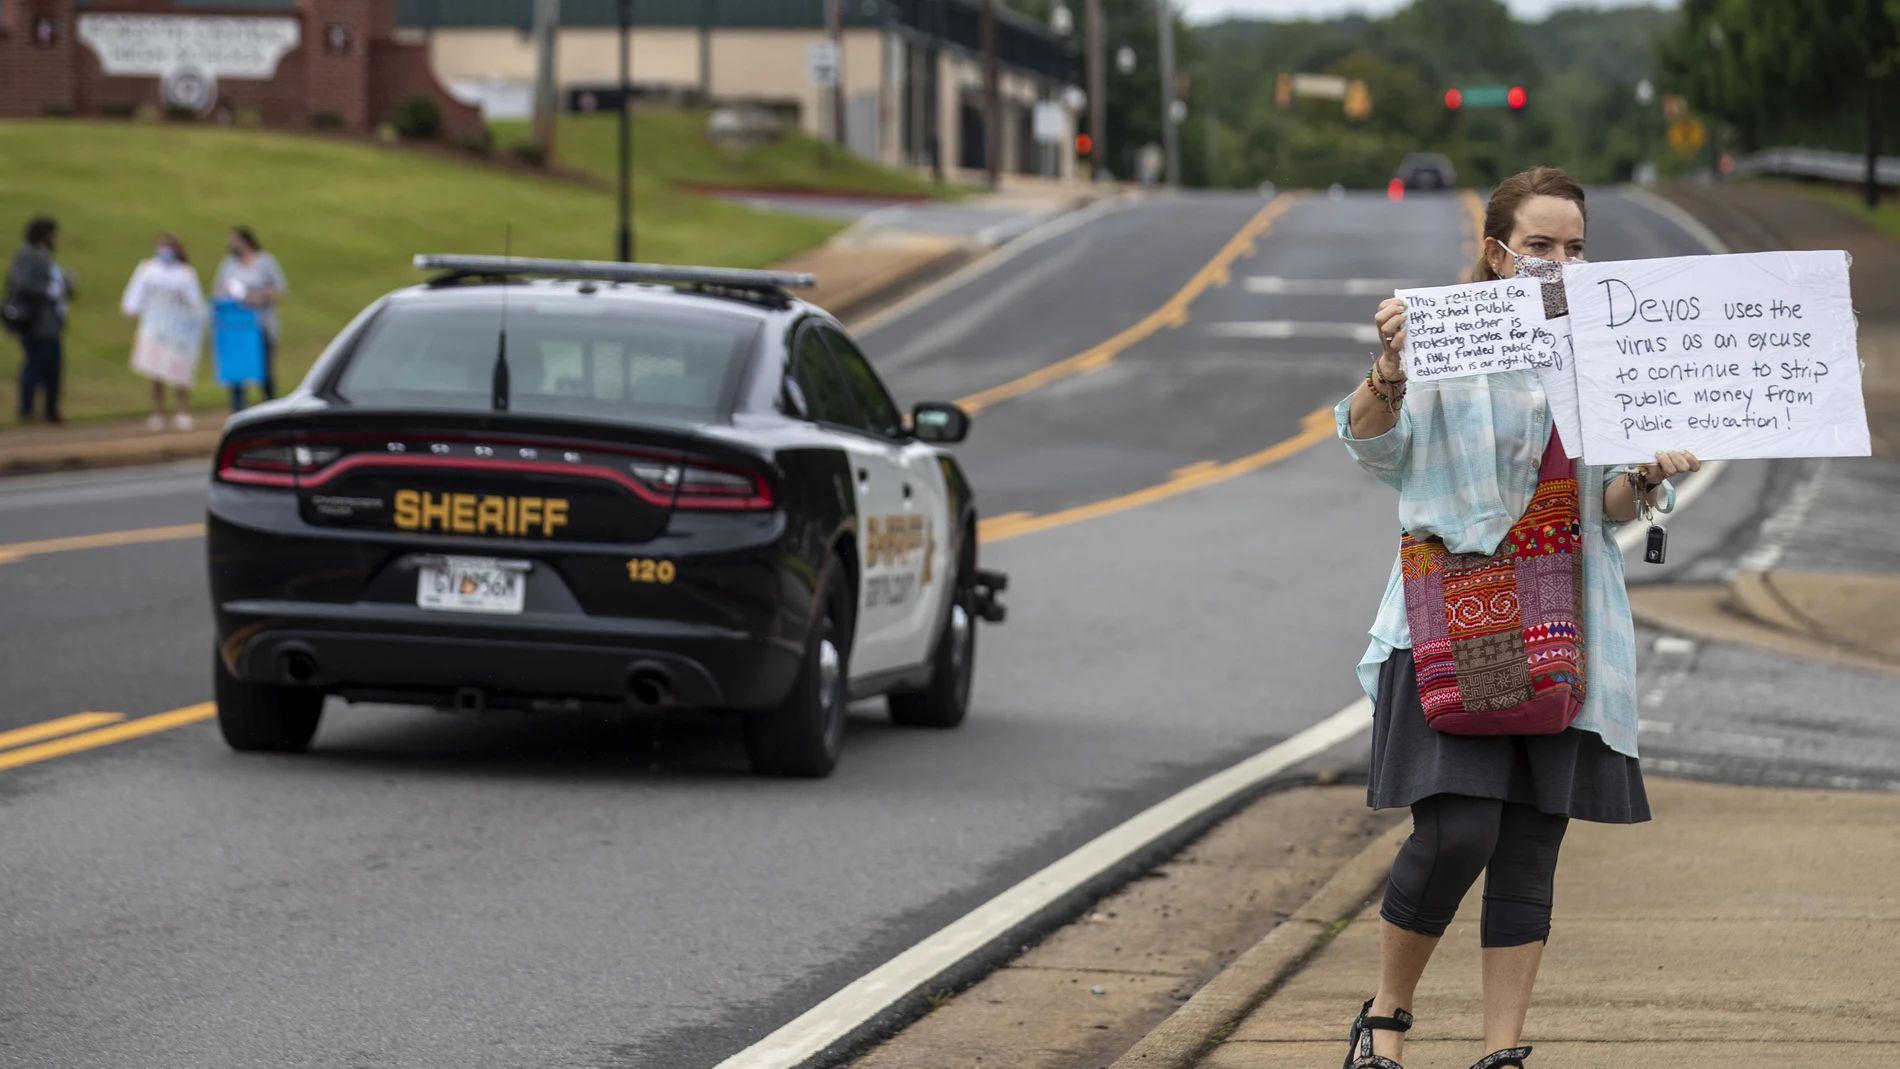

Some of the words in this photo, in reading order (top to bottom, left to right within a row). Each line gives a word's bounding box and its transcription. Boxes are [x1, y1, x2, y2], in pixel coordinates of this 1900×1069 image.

[1406, 295, 1436, 308] This
[1445, 287, 1498, 306] retired
[1724, 302, 1763, 320] uses
[1770, 298, 1803, 320] the
[1454, 319, 1504, 333] teacher
[1511, 317, 1522, 329] is
[1412, 335, 1465, 353] protesting
[1509, 328, 1528, 340] for
[1615, 334, 1668, 356] virus
[1682, 333, 1702, 350] as
[1714, 334, 1738, 348] an
[1747, 331, 1812, 351] excuse
[1413, 356, 1422, 367] A
[1469, 361, 1477, 370] is
[1480, 360, 1494, 368] our
[1615, 366, 1638, 384] to
[1648, 361, 1740, 381] continue
[1751, 360, 1772, 377] to
[1693, 387, 1753, 412] money
[1620, 415, 1673, 440] public
[393, 488, 571, 538] SHERIFF
[626, 558, 677, 584] 120
